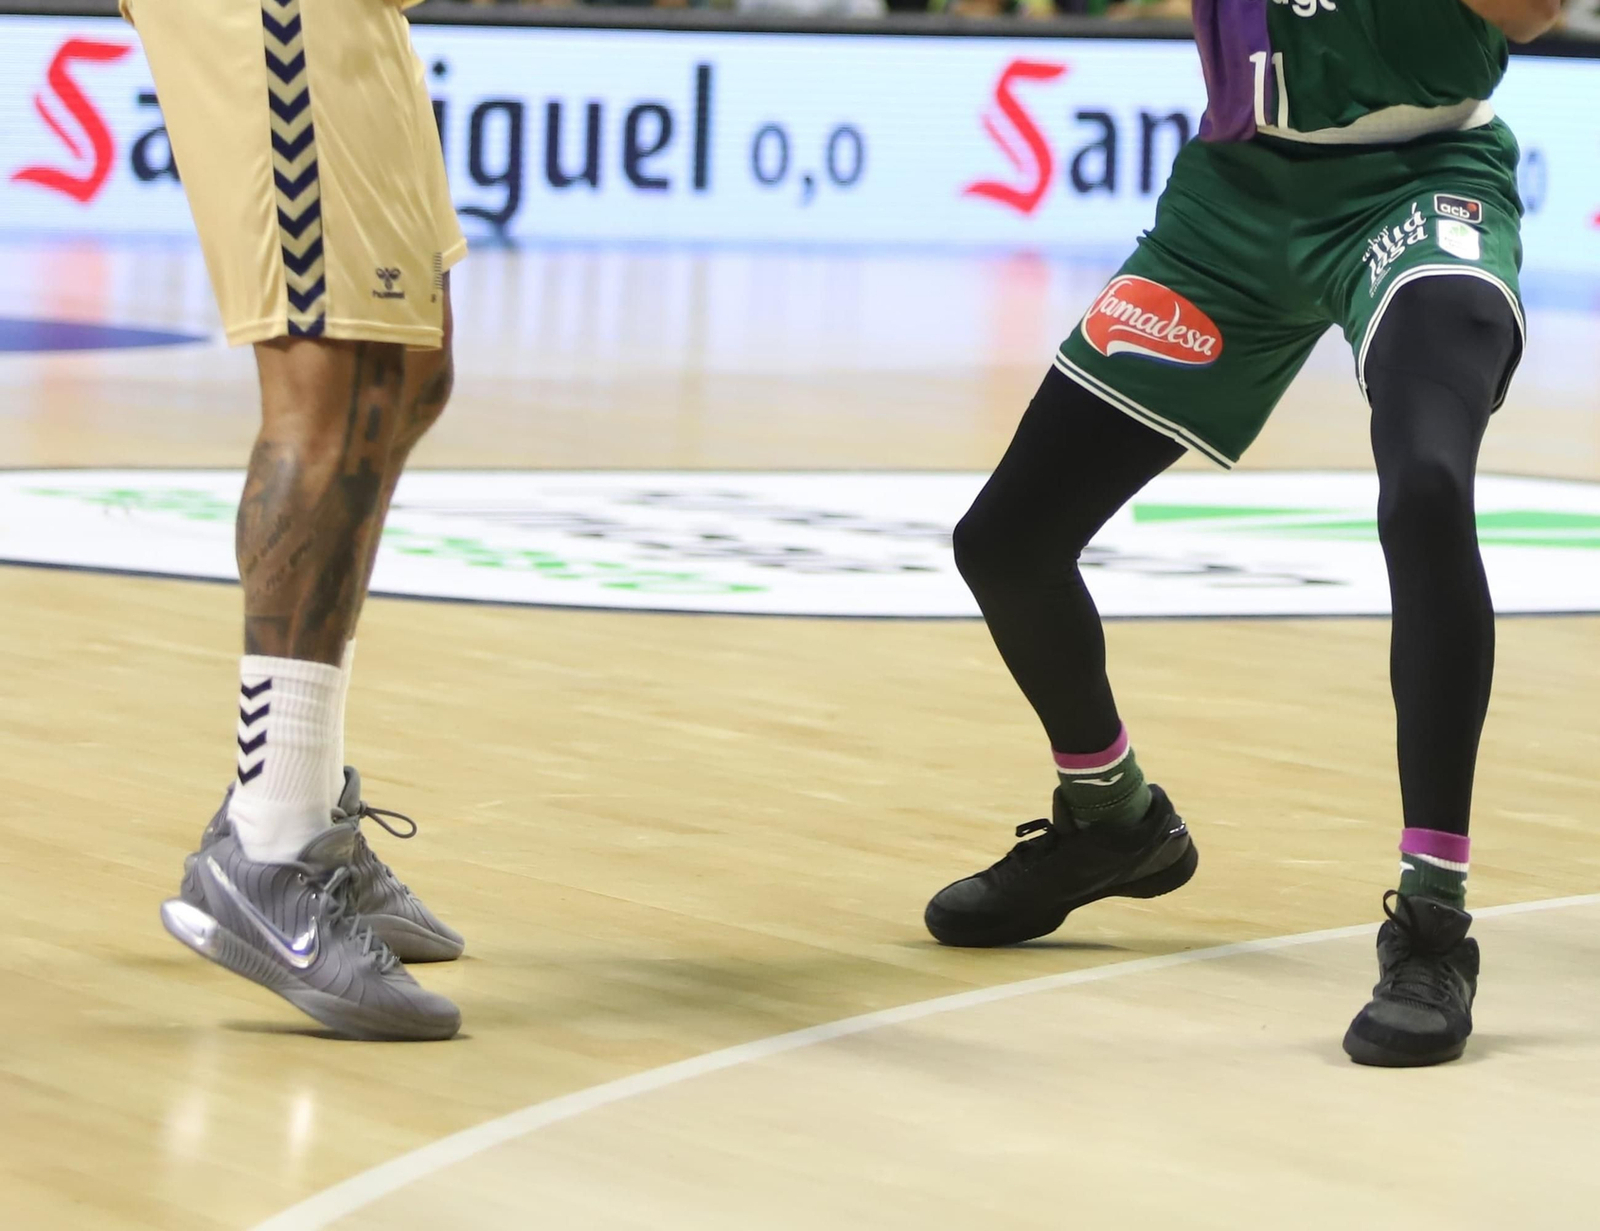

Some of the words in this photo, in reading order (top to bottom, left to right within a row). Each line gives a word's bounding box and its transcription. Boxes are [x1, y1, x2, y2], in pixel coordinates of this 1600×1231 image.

[11, 40, 181, 202] Sa
[431, 59, 715, 239] iguel
[1440, 202, 1470, 219] acb
